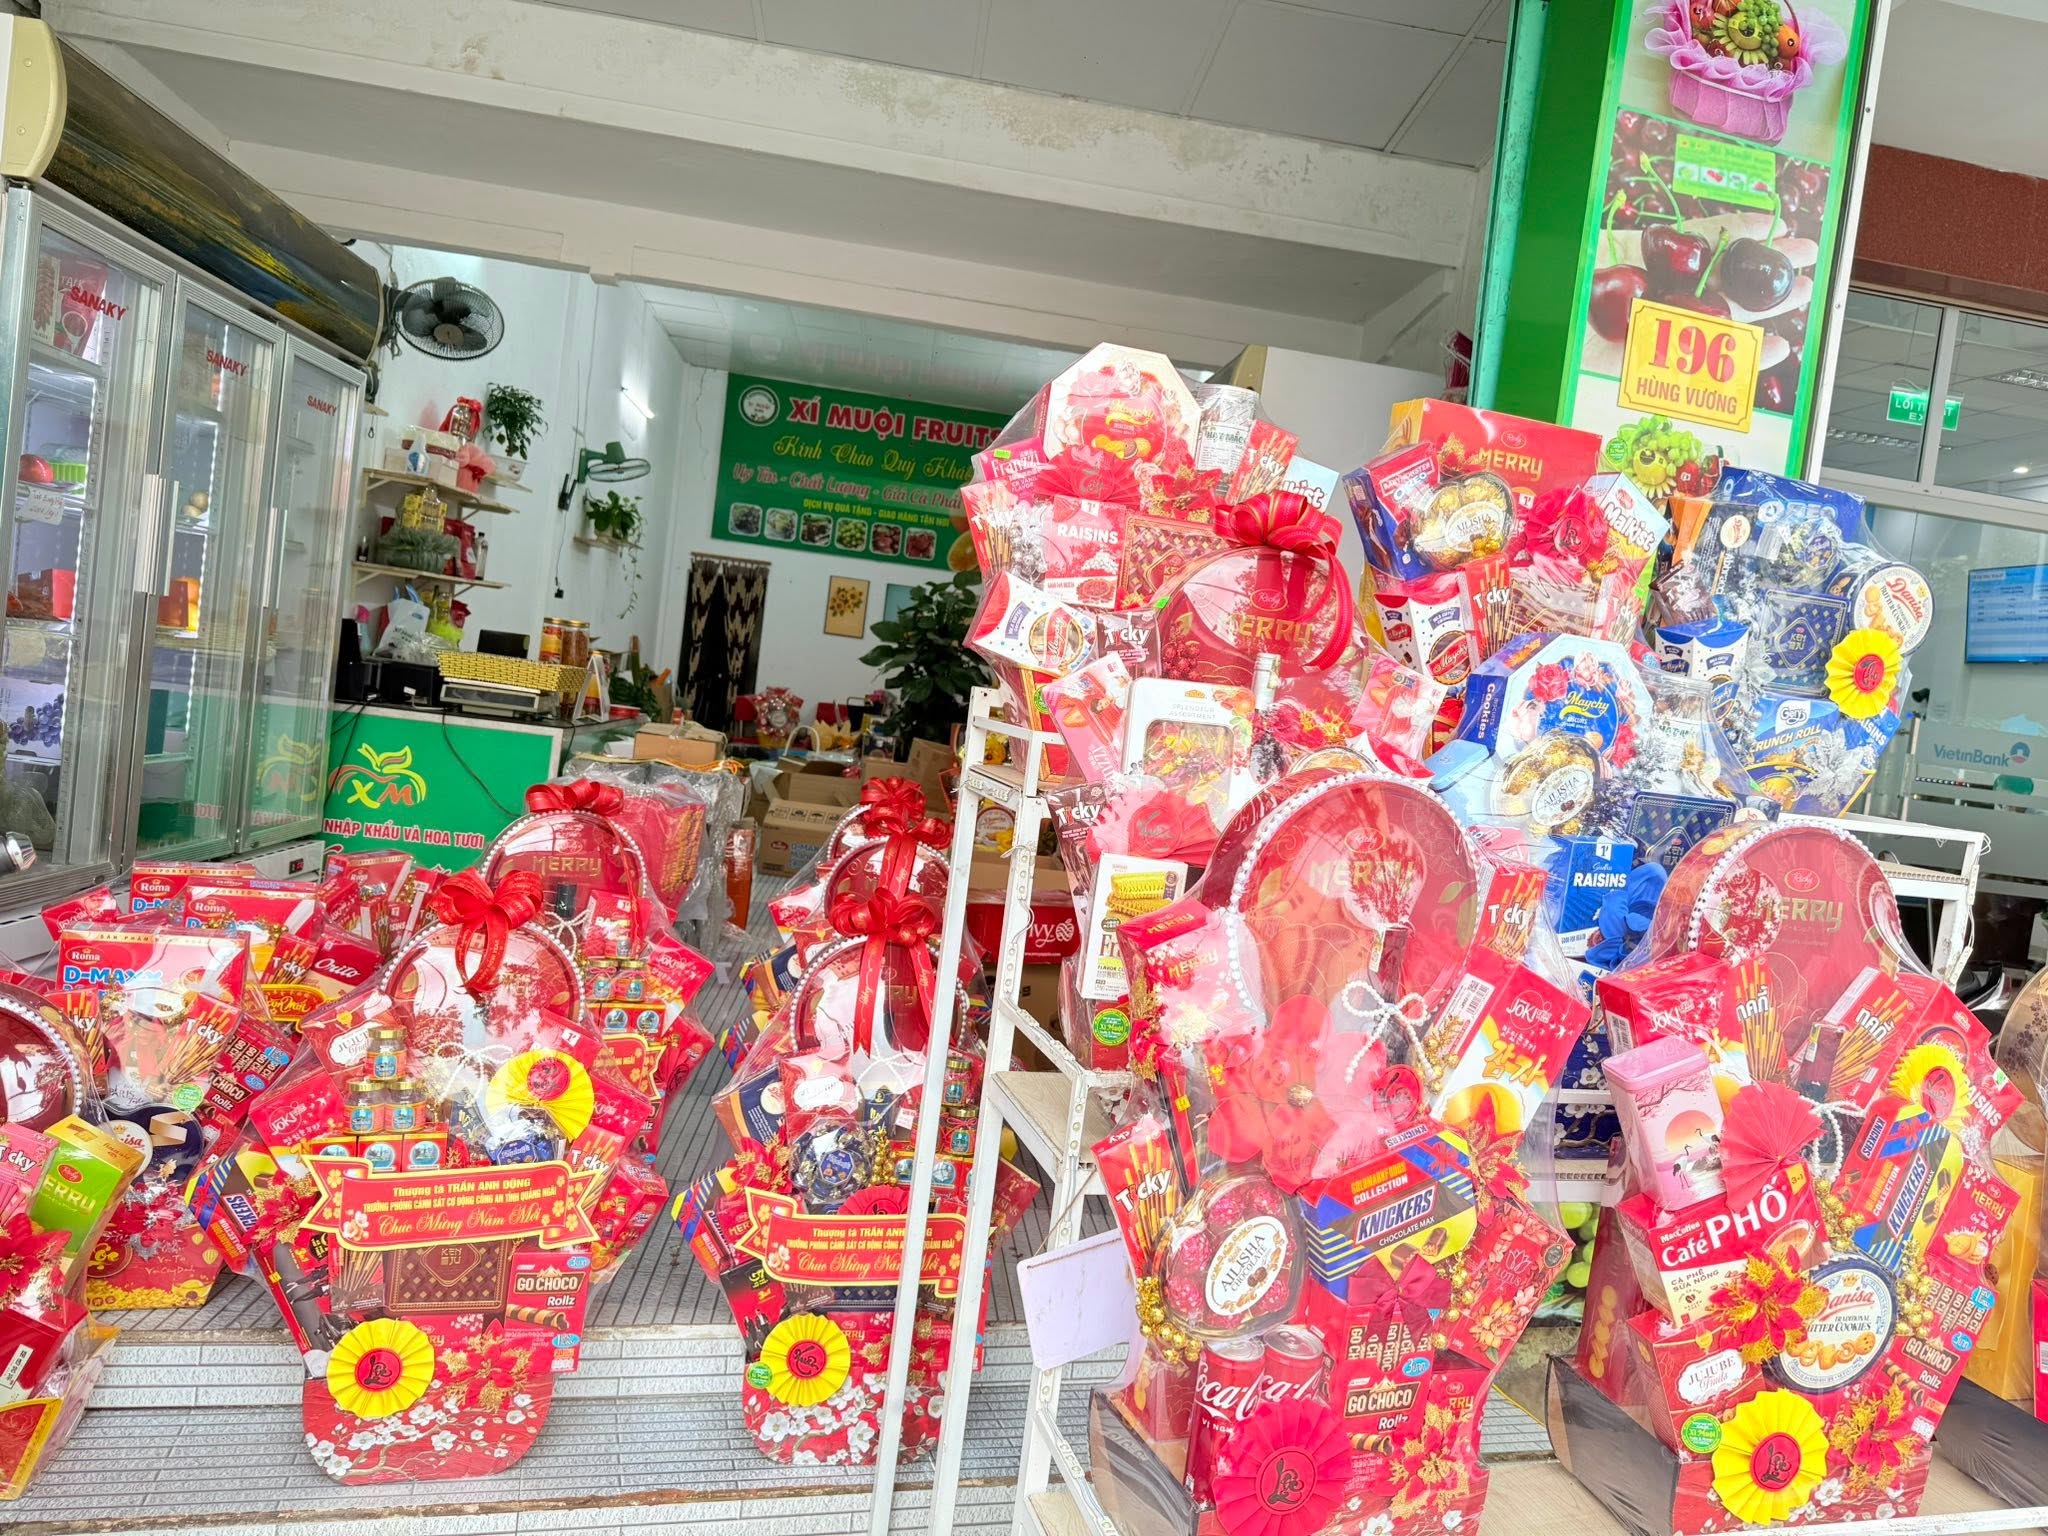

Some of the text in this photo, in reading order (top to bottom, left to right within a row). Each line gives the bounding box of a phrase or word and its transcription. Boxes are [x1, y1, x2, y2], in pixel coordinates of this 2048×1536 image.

[70, 286, 127, 321] SANAKY
[206, 349, 247, 377] SANAKY
[1649, 317, 1736, 383] 196
[307, 395, 337, 417] SANAKY
[1636, 376, 1737, 415] HÙNG VƯƠNG
[787, 396, 821, 425] XÍ
[825, 403, 905, 440] MUỘI
[1478, 447, 1543, 482] MERRY
[1057, 524, 1119, 545] RAISINS
[1604, 501, 1656, 552] Malkist
[1885, 577, 1923, 620] Danisa
[1104, 625, 1150, 647] Ticky
[1477, 683, 1496, 739] Cookies
[1749, 723, 1823, 753] CRUNCH ROLL
[1934, 743, 2009, 768] VietinBank
[1056, 801, 1101, 826] Ticky
[324, 818, 485, 850] NHẬP KHẨU VÀ HOA TƯƠI
[532, 856, 603, 877] MERRY
[1573, 872, 1628, 888] RAISINS
[140, 882, 170, 893] Roma
[195, 901, 226, 913] Roma
[71, 950, 100, 961] Roma
[211, 1076, 246, 1101] CHOCO
[211, 1094, 234, 1111] Rollz
[1967, 1085, 2002, 1127] AISINS
[1862, 1117, 1886, 1159] KNICKERS
[393, 1187, 431, 1197] Thượng
[478, 1180, 499, 1191] ANH
[1115, 1168, 1172, 1213] Ticky
[1353, 1174, 1408, 1205] COLLECTION
[1872, 1165, 1901, 1217] COLLECTION
[1888, 1153, 1927, 1237] KNICKERS
[1909, 1169, 1935, 1223] CHOCOLATE MAX
[1356, 1187, 1434, 1243] KNICKERS
[1971, 1189, 2006, 1220] MERRY
[886, 1227, 905, 1237] ANH
[1379, 1215, 1435, 1247] CHOCOLATE MAX
[1660, 1220, 1700, 1243] MacCoffee
[1661, 1175, 1788, 1267] Café PHỐ
[219, 1219, 247, 1254] COLLECTION
[1221, 1234, 1266, 1292] AILISHA
[1231, 1245, 1268, 1293] CHOCOLATE
[1671, 1269, 1705, 1286] CÀ PHÊ
[516, 1276, 578, 1291] GO CHOCO
[1673, 1281, 1692, 1293] SỮA
[1829, 1286, 1875, 1309] anisa
[547, 1295, 576, 1306] Rollz
[1835, 1321, 1871, 1333] COOKIES
[1905, 1337, 1952, 1372] GO CHOCO
[1688, 1356, 1737, 1386] JUJUBE
[1919, 1369, 1942, 1390] Rollz
[1347, 1388, 1412, 1414] GO CHOCO
